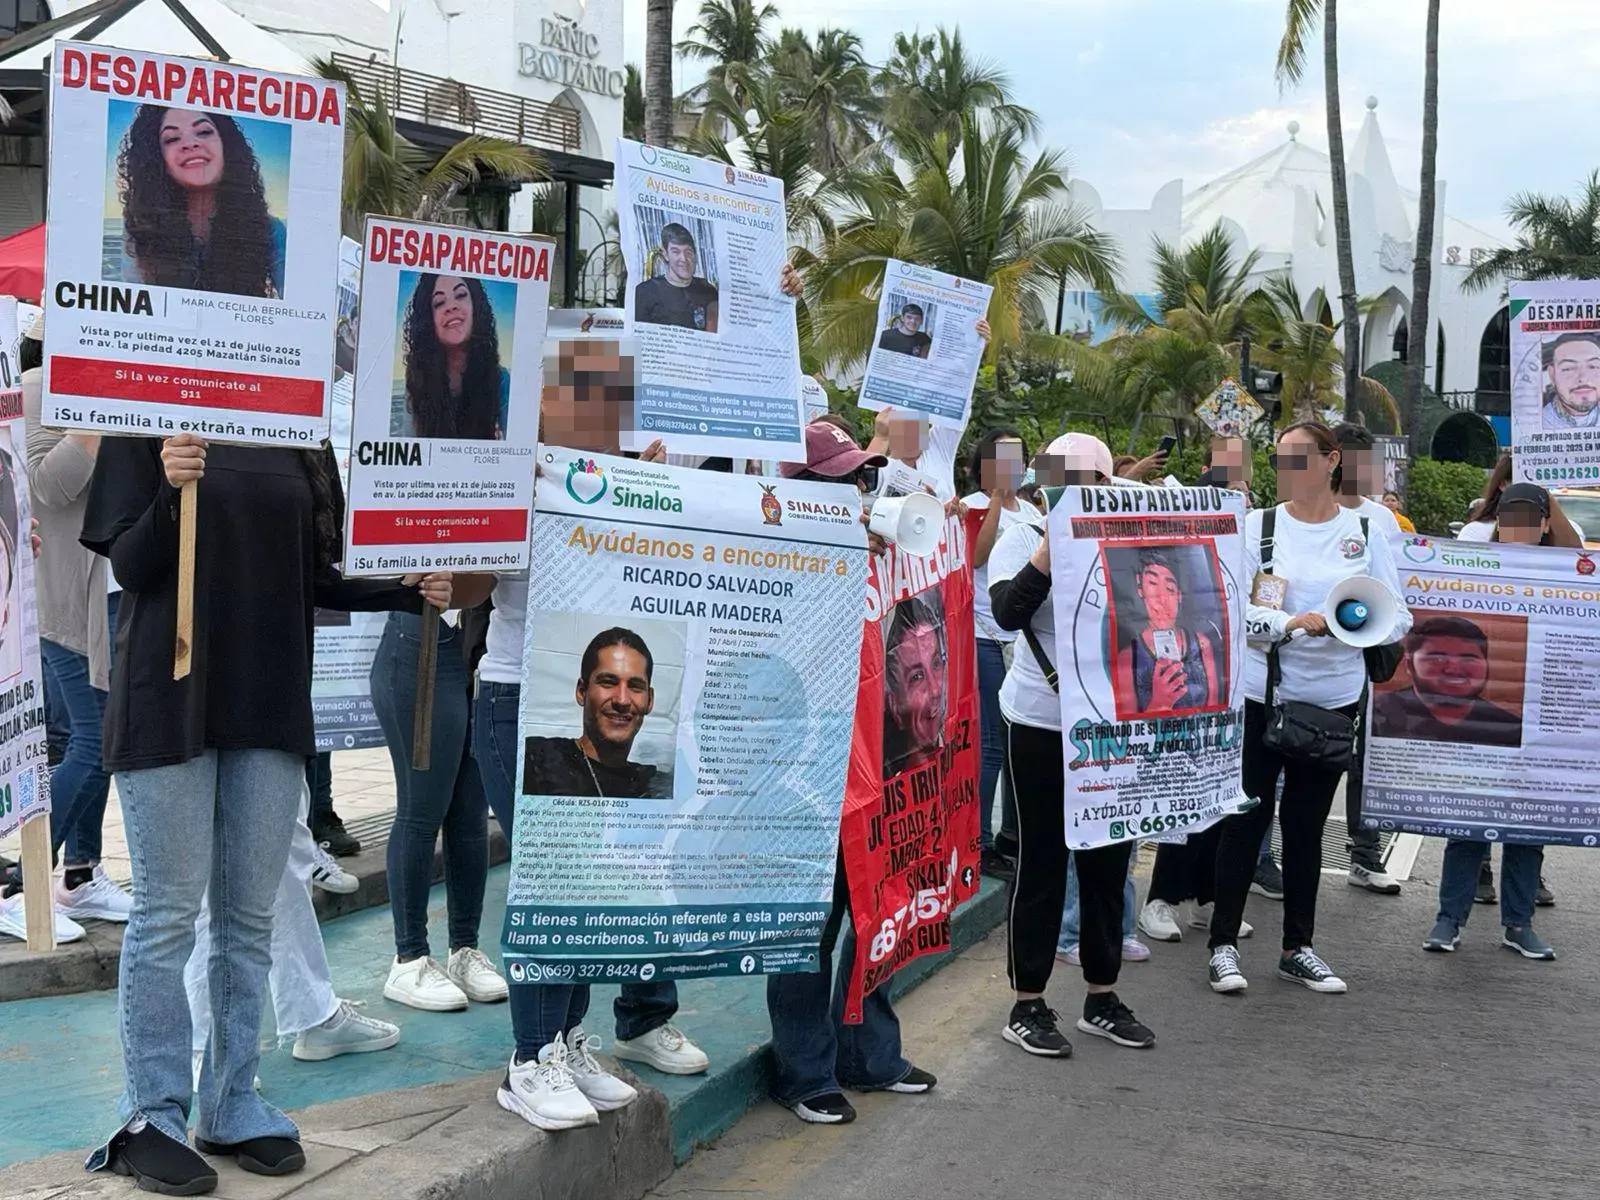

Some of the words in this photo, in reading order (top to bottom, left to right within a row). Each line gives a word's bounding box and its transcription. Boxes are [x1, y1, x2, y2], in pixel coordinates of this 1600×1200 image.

[62, 48, 341, 126] DESAPARECIDA
[659, 156, 691, 174] Sinaloa
[737, 171, 767, 184] SINALOA
[646, 176, 700, 200] Ayúdanos
[702, 192, 710, 202] a
[712, 194, 763, 215] encontrar
[763, 207, 772, 217] a
[660, 198, 706, 217] ALEJANDRO
[707, 208, 747, 226] MARTINEZ
[369, 227, 549, 282] DESAPARECIDA
[55, 281, 154, 316] CHINA
[181, 297, 215, 308] MARIA
[217, 301, 258, 313] CECILIA
[261, 306, 327, 320] BERRELLEZA
[234, 313, 275, 325] FLORES
[80, 325, 110, 336] Vista
[113, 330, 134, 339] por
[136, 332, 174, 343] ultima
[177, 337, 198, 345] vez
[200, 338, 211, 347] el
[214, 340, 226, 348] 21
[229, 340, 244, 350] de
[245, 342, 272, 353] julio
[275, 346, 301, 357] 2025
[79, 338, 94, 346] en
[97, 340, 114, 348] av.
[118, 340, 129, 350] la
[132, 342, 173, 354] piedad
[175, 348, 203, 358] 4205
[206, 349, 257, 362] Mazatlán
[260, 354, 301, 366] Sinaloa
[115, 369, 127, 379] Si
[131, 371, 143, 381] la
[147, 374, 169, 384] vez
[249, 383, 261, 392] al
[180, 390, 201, 399] 911
[55, 407, 83, 422] ¡Su
[89, 410, 152, 427] familia
[158, 416, 174, 430] la
[180, 420, 246, 435] extraña
[251, 427, 313, 441] mucho!
[358, 441, 422, 466] CHINA
[463, 446, 490, 455] CECILIA
[491, 447, 532, 456] BERRELLEZA
[473, 456, 500, 464] FLORES
[610, 466, 640, 476] Comisión
[640, 470, 661, 479] Estatal
[373, 480, 394, 488] Vista
[410, 480, 435, 489] ultima
[451, 481, 459, 489] el
[470, 481, 480, 489] de
[480, 481, 498, 490] julio
[498, 482, 515, 490] 2025
[397, 490, 406, 498] la
[407, 490, 434, 500] piedad
[435, 491, 454, 500] 4205
[489, 490, 515, 498] Sinaloa
[612, 486, 683, 513] Sinaloa
[787, 500, 852, 518] SINALOA
[395, 517, 404, 526] Si
[405, 517, 414, 526] la
[415, 518, 431, 526] vez
[481, 517, 490, 525] al
[787, 512, 818, 521] GOBIERNO
[830, 518, 853, 526] ESTADO
[436, 529, 451, 538] 911
[567, 526, 695, 560] Ayúdanos
[702, 545, 716, 562] a
[723, 548, 829, 574] encontrar
[834, 556, 848, 576] a
[354, 557, 374, 570] ¡Su
[377, 556, 417, 568] familia
[421, 555, 432, 567] la
[435, 554, 478, 567] extraña
[480, 553, 520, 565] mucho!
[1441, 554, 1501, 569] Sinaloa
[623, 566, 702, 589] RICARDO
[706, 574, 794, 597] SALVADOR
[1405, 576, 1516, 596] Ayúdanos
[1522, 587, 1535, 597] a
[630, 596, 707, 617] AGUILAR
[711, 603, 783, 624] MADERA
[1404, 595, 1457, 608] OSCAR
[1462, 599, 1513, 612] DAVID
[709, 626, 728, 635] Fecha
[551, 798, 577, 806] Cédula:
[510, 912, 526, 926] Si
[532, 912, 578, 925] tienes
[584, 912, 667, 925] información
[672, 911, 728, 924] referente
[732, 912, 740, 923] a
[745, 910, 772, 923] esta
[507, 931, 548, 945] llama
[551, 934, 562, 944] o
[565, 932, 648, 944] escribenos.
[653, 931, 669, 942] Tu
[672, 930, 709, 942] ayuda
[711, 931, 726, 941] es
[728, 930, 757, 940] muy
[542, 964, 575, 979] (669)
[578, 964, 604, 977] 327
[605, 964, 638, 977] 8424
